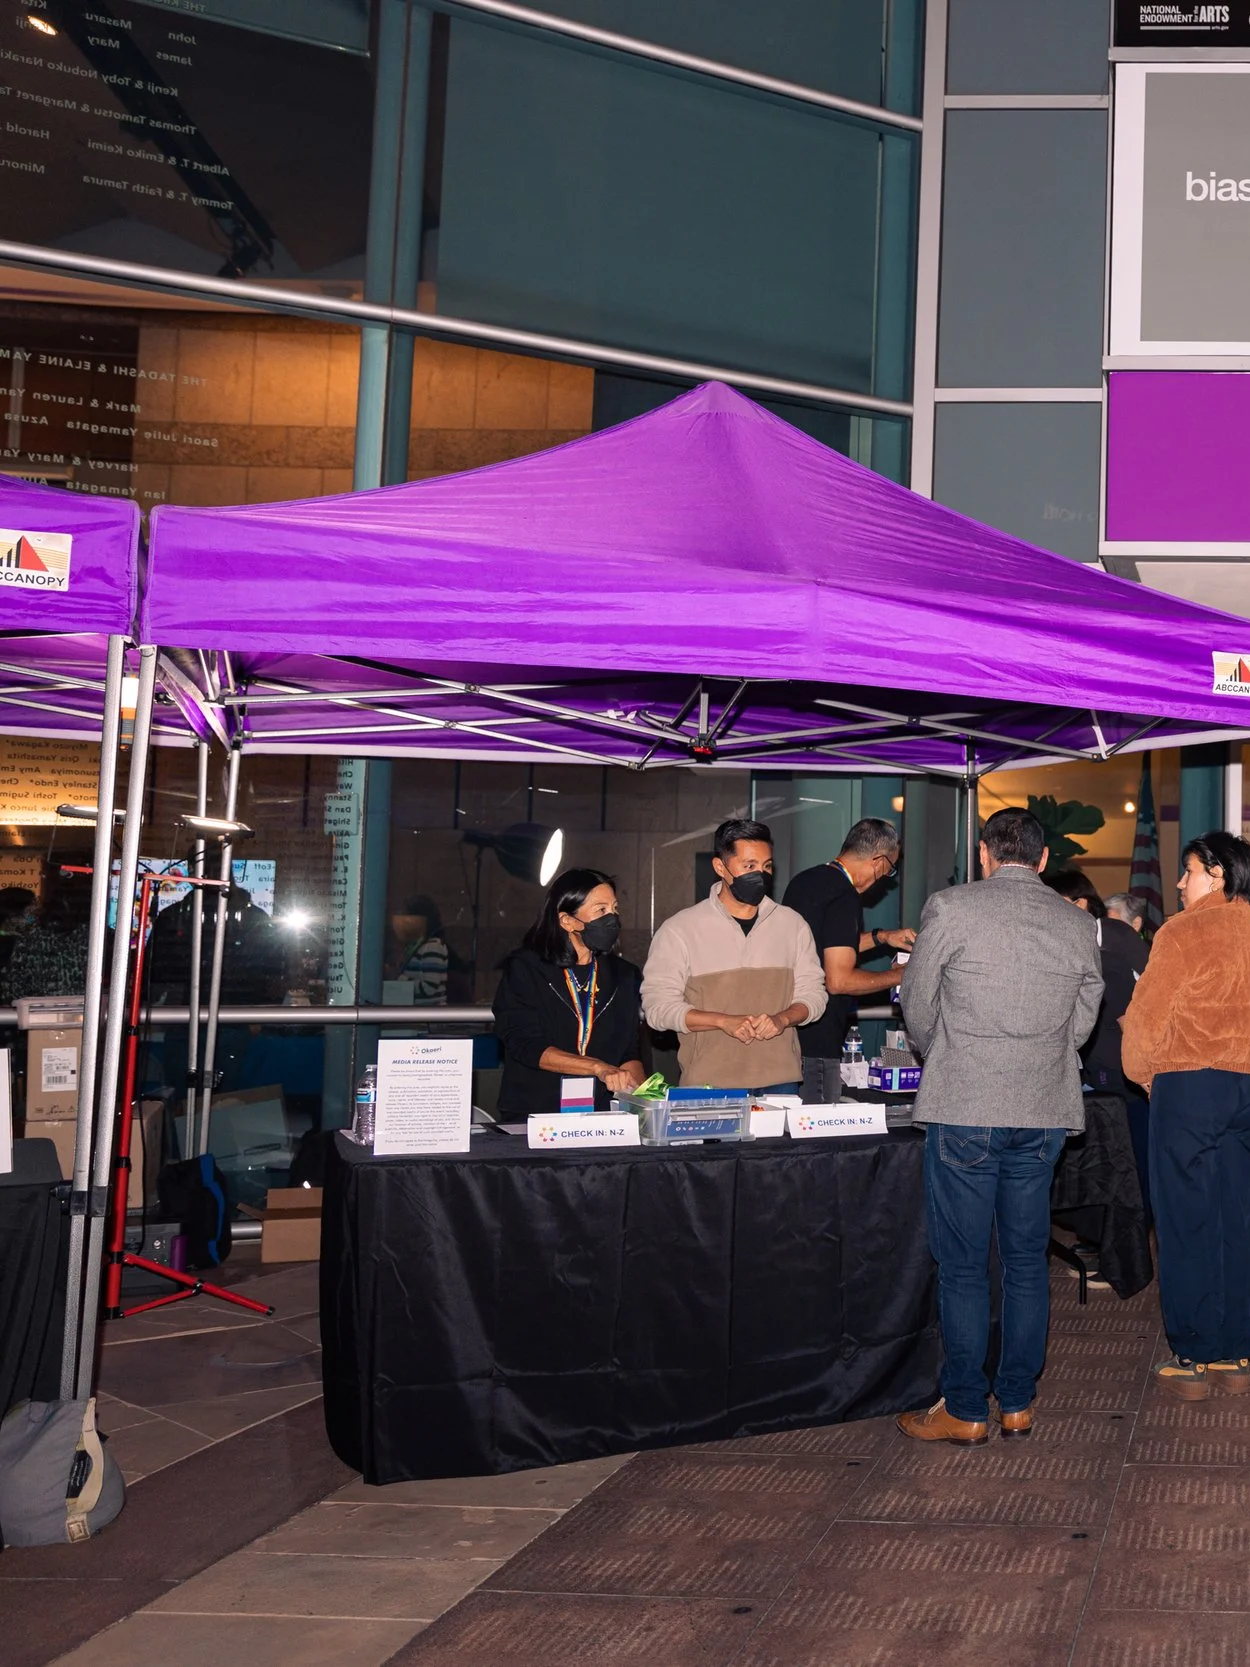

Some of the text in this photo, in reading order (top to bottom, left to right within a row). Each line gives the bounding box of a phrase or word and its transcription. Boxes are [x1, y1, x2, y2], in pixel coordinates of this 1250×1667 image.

[1140, 5, 1182, 14] NATIONAL
[1199, 5, 1230, 23] ARTS
[1140, 14, 1193, 23] ENDOWMENT
[0, 571, 65, 587] CANOPY
[561, 1130, 593, 1138] CHECK
